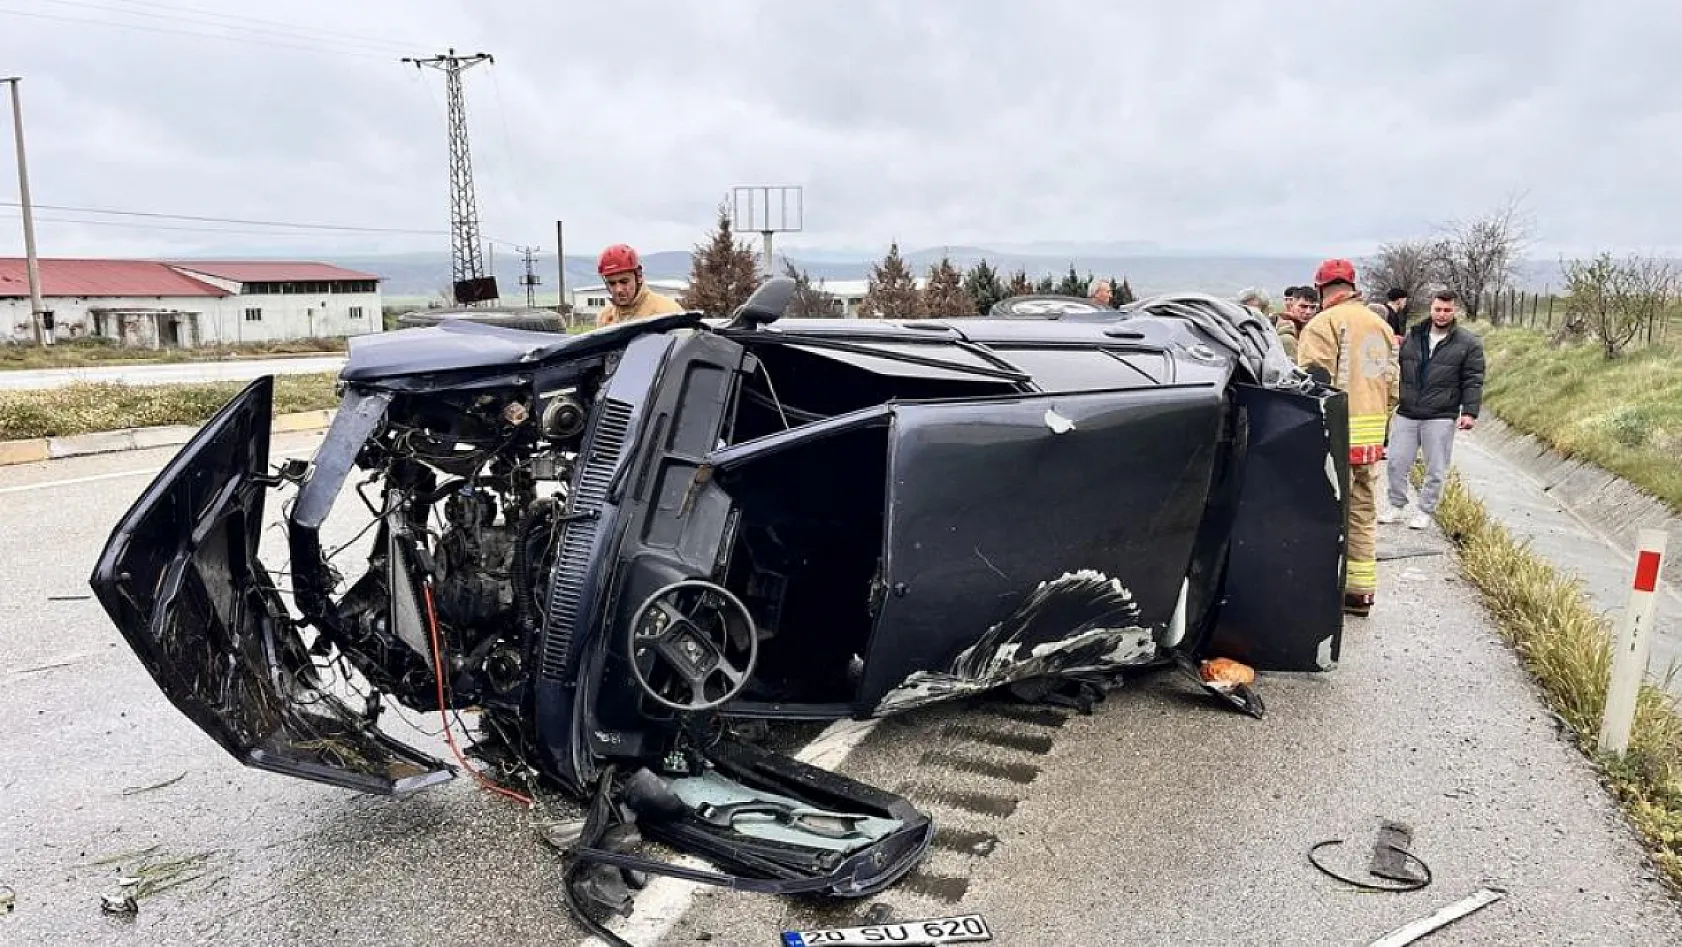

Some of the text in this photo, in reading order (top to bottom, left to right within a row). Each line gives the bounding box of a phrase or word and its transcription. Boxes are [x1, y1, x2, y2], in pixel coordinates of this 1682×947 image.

[807, 931, 845, 944] 20
[860, 926, 909, 941] SU
[923, 917, 984, 938] 620
